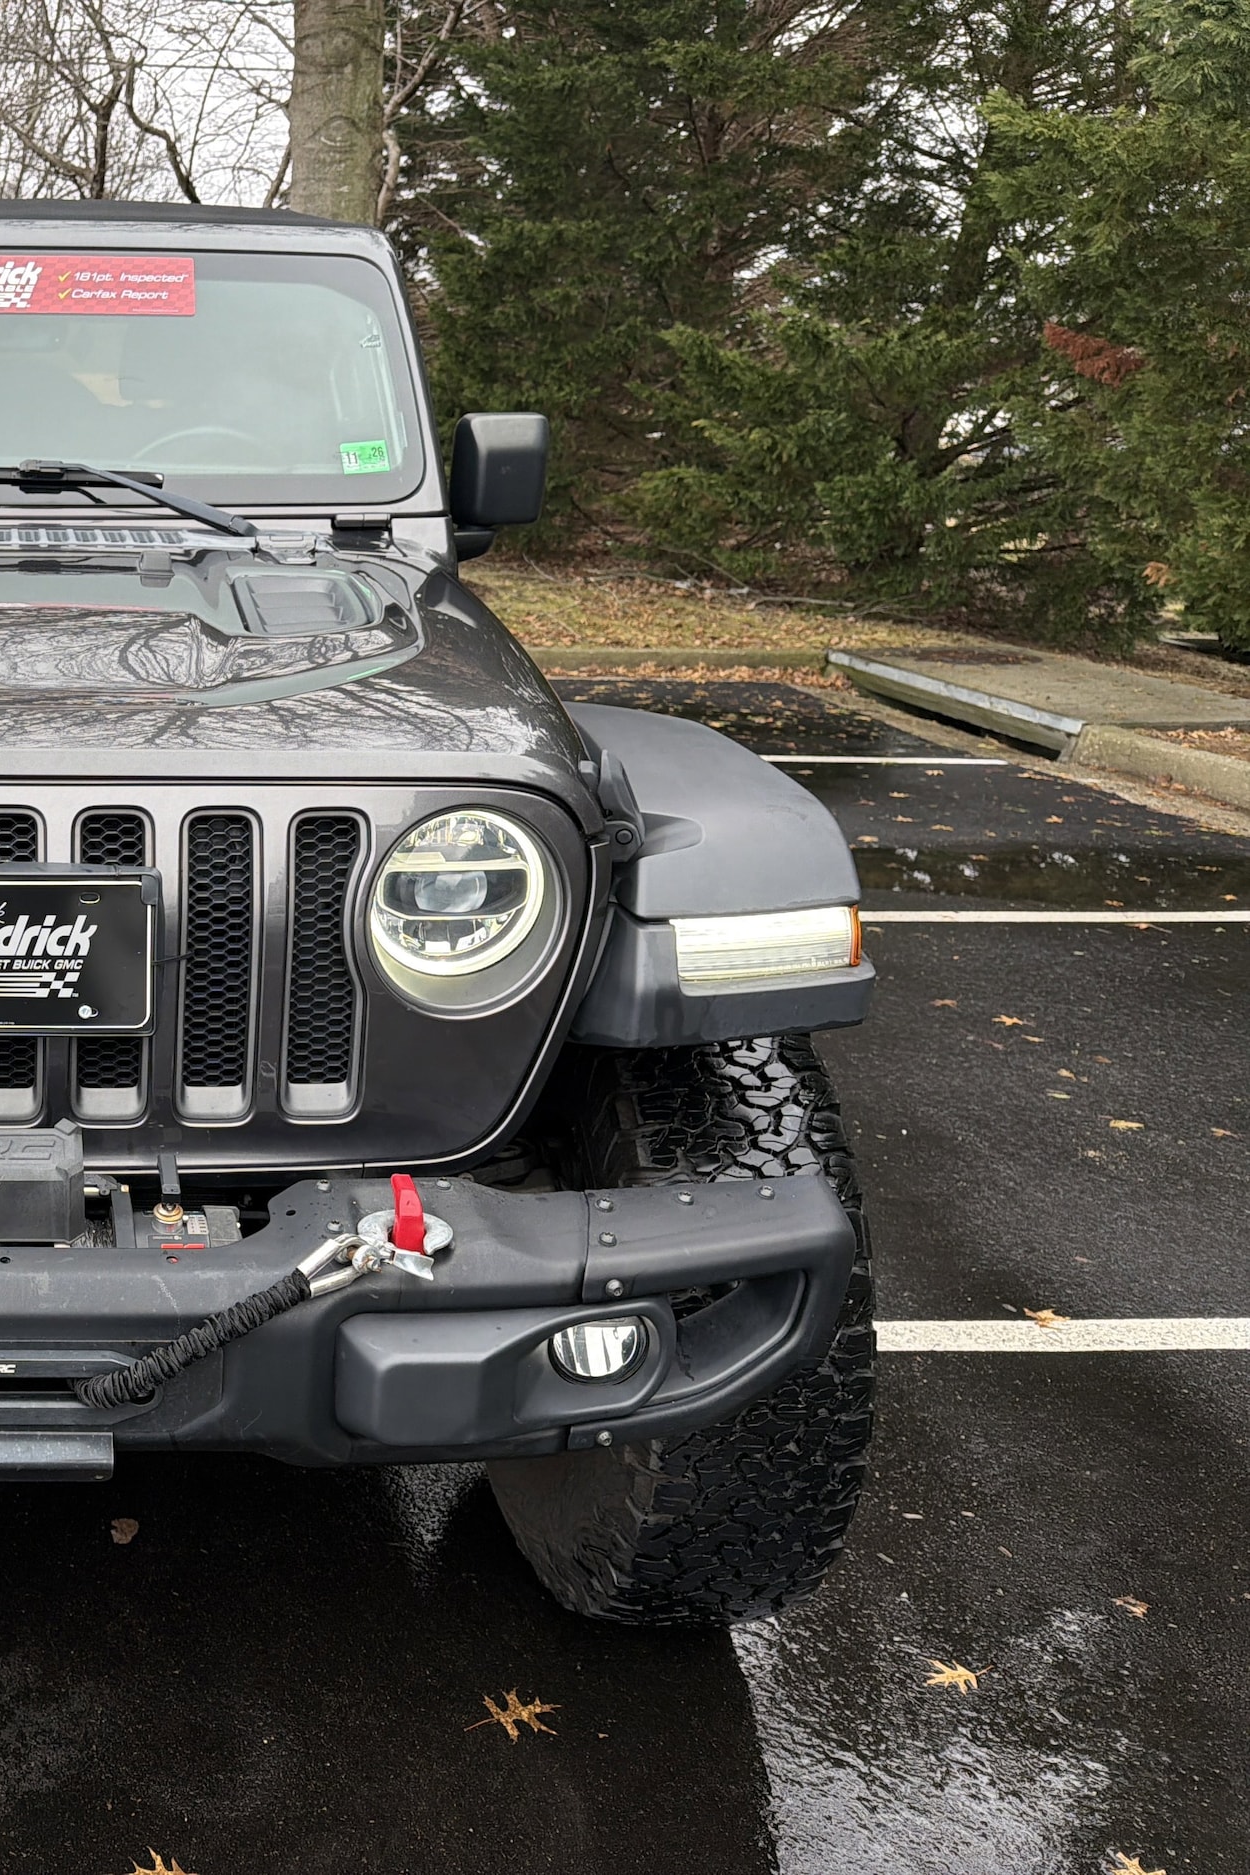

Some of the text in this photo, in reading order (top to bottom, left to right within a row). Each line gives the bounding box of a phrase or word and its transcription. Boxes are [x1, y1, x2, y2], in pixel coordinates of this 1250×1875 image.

[73, 272, 114, 283] 181pt.
[71, 289, 169, 300] Carfax Report
[371, 446, 384, 458] 26
[12, 959, 51, 970] BUICK
[54, 959, 84, 970] GMC
